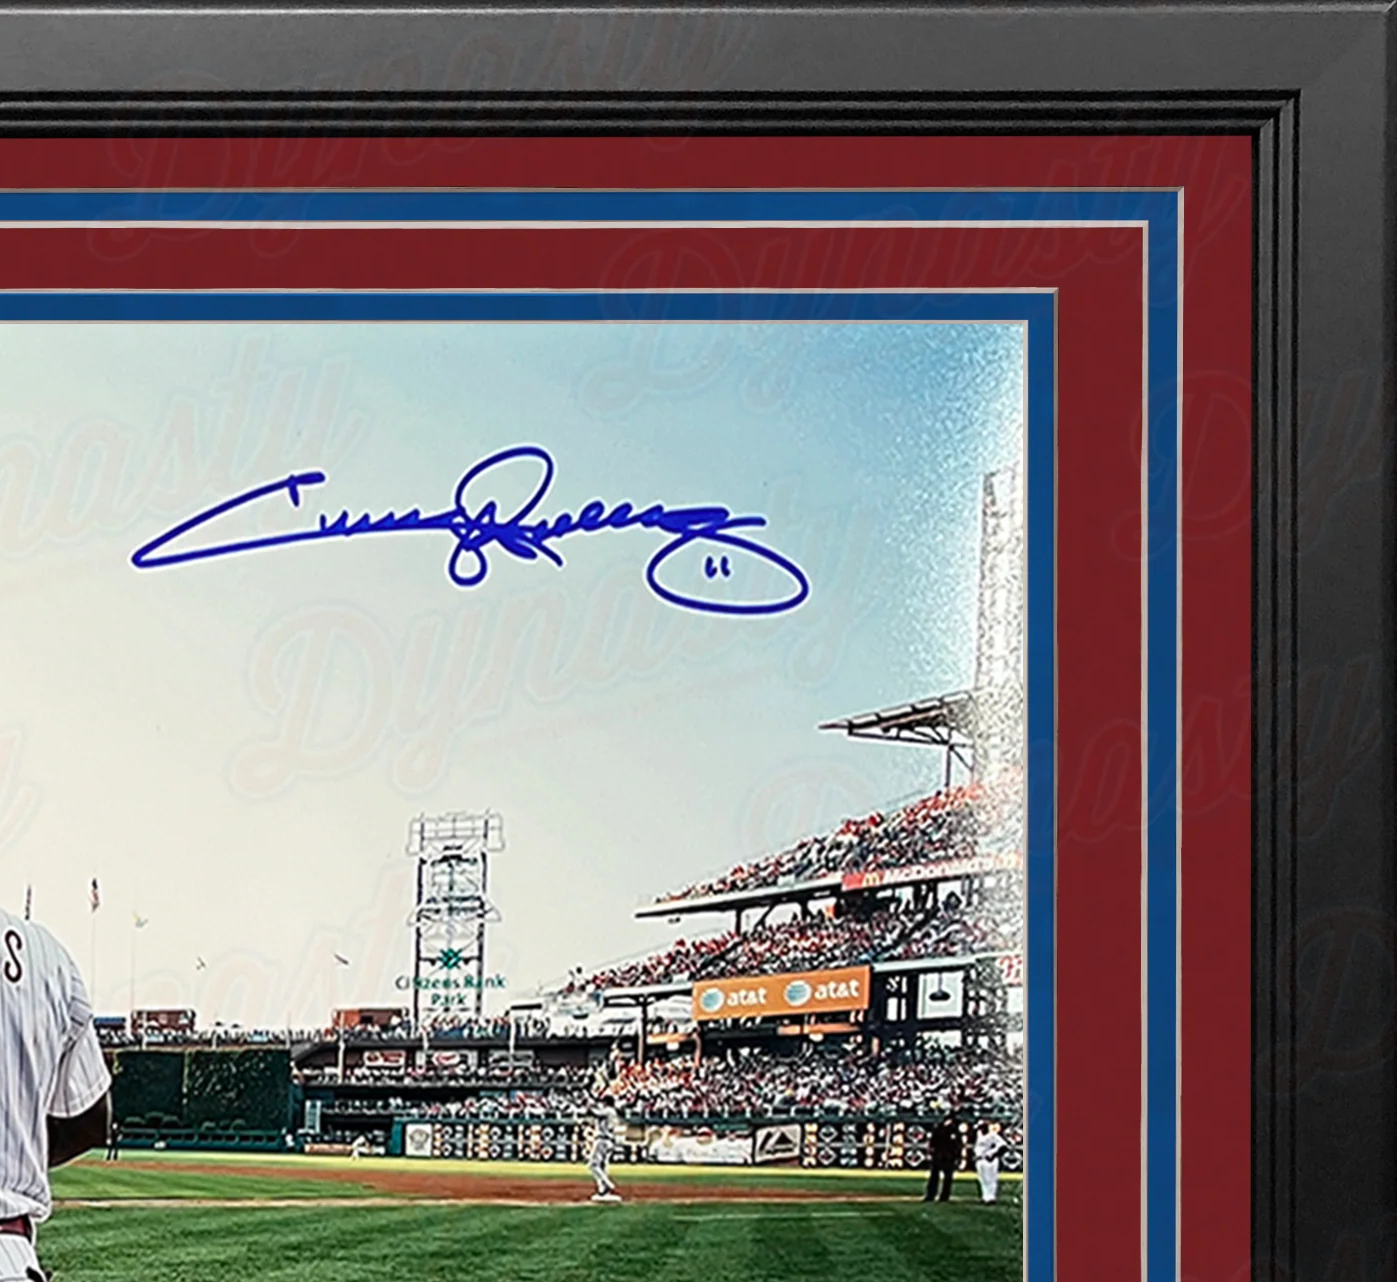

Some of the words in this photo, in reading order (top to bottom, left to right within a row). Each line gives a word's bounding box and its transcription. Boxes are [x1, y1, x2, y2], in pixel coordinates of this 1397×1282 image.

[395, 975, 460, 990] Citizens
[464, 974, 507, 989] Bank
[814, 979, 859, 1001] at&t
[726, 986, 767, 1007] at&t
